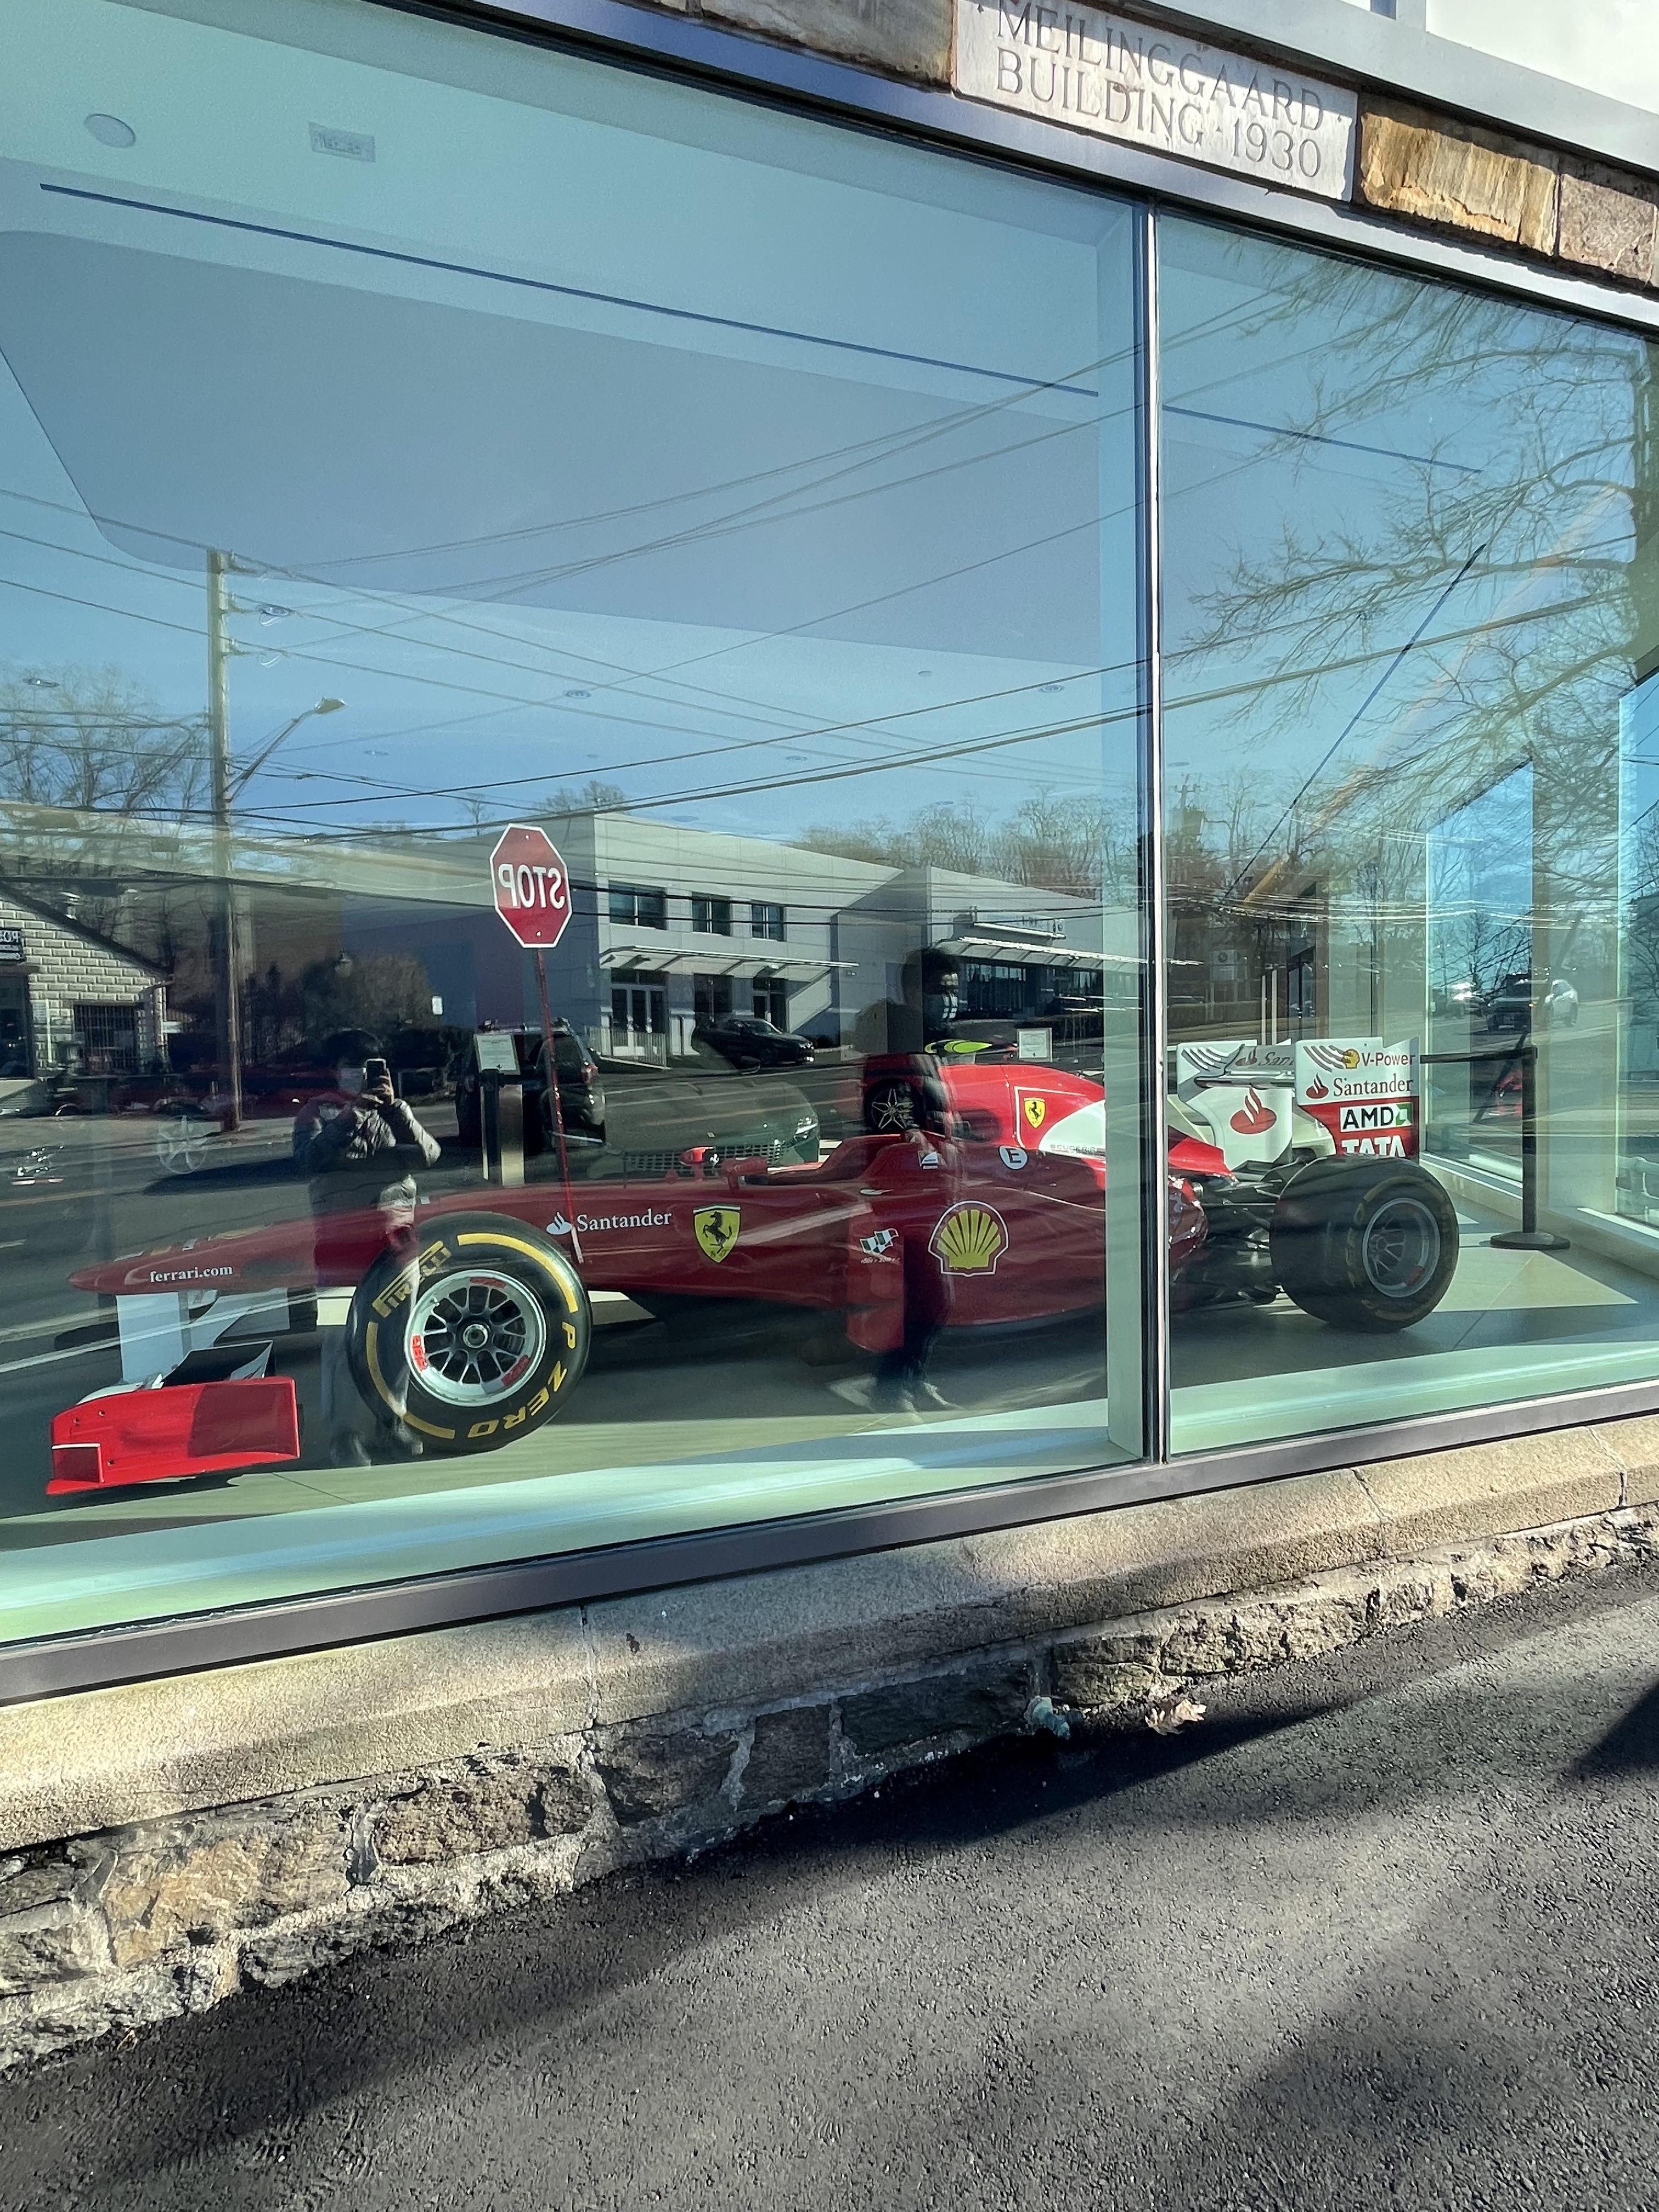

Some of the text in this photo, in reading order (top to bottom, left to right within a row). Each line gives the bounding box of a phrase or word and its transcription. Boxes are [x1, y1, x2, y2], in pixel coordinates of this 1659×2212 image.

[997, 0, 1323, 131] MEILINGGAARD
[997, 47, 1321, 178] BUILDING 1930
[1361, 1052, 1416, 1066] V-Power
[1333, 1073, 1414, 1097] Santander
[1342, 1106, 1394, 1130] AMD
[1005, 1148, 1022, 1164] E
[1341, 1135, 1406, 1158] TATA
[577, 1209, 672, 1232] Santander
[150, 1266, 233, 1283] ferrari.com
[372, 1240, 452, 1318] PIRLLI
[562, 1321, 576, 1349] P
[467, 1361, 567, 1438] ZERO
